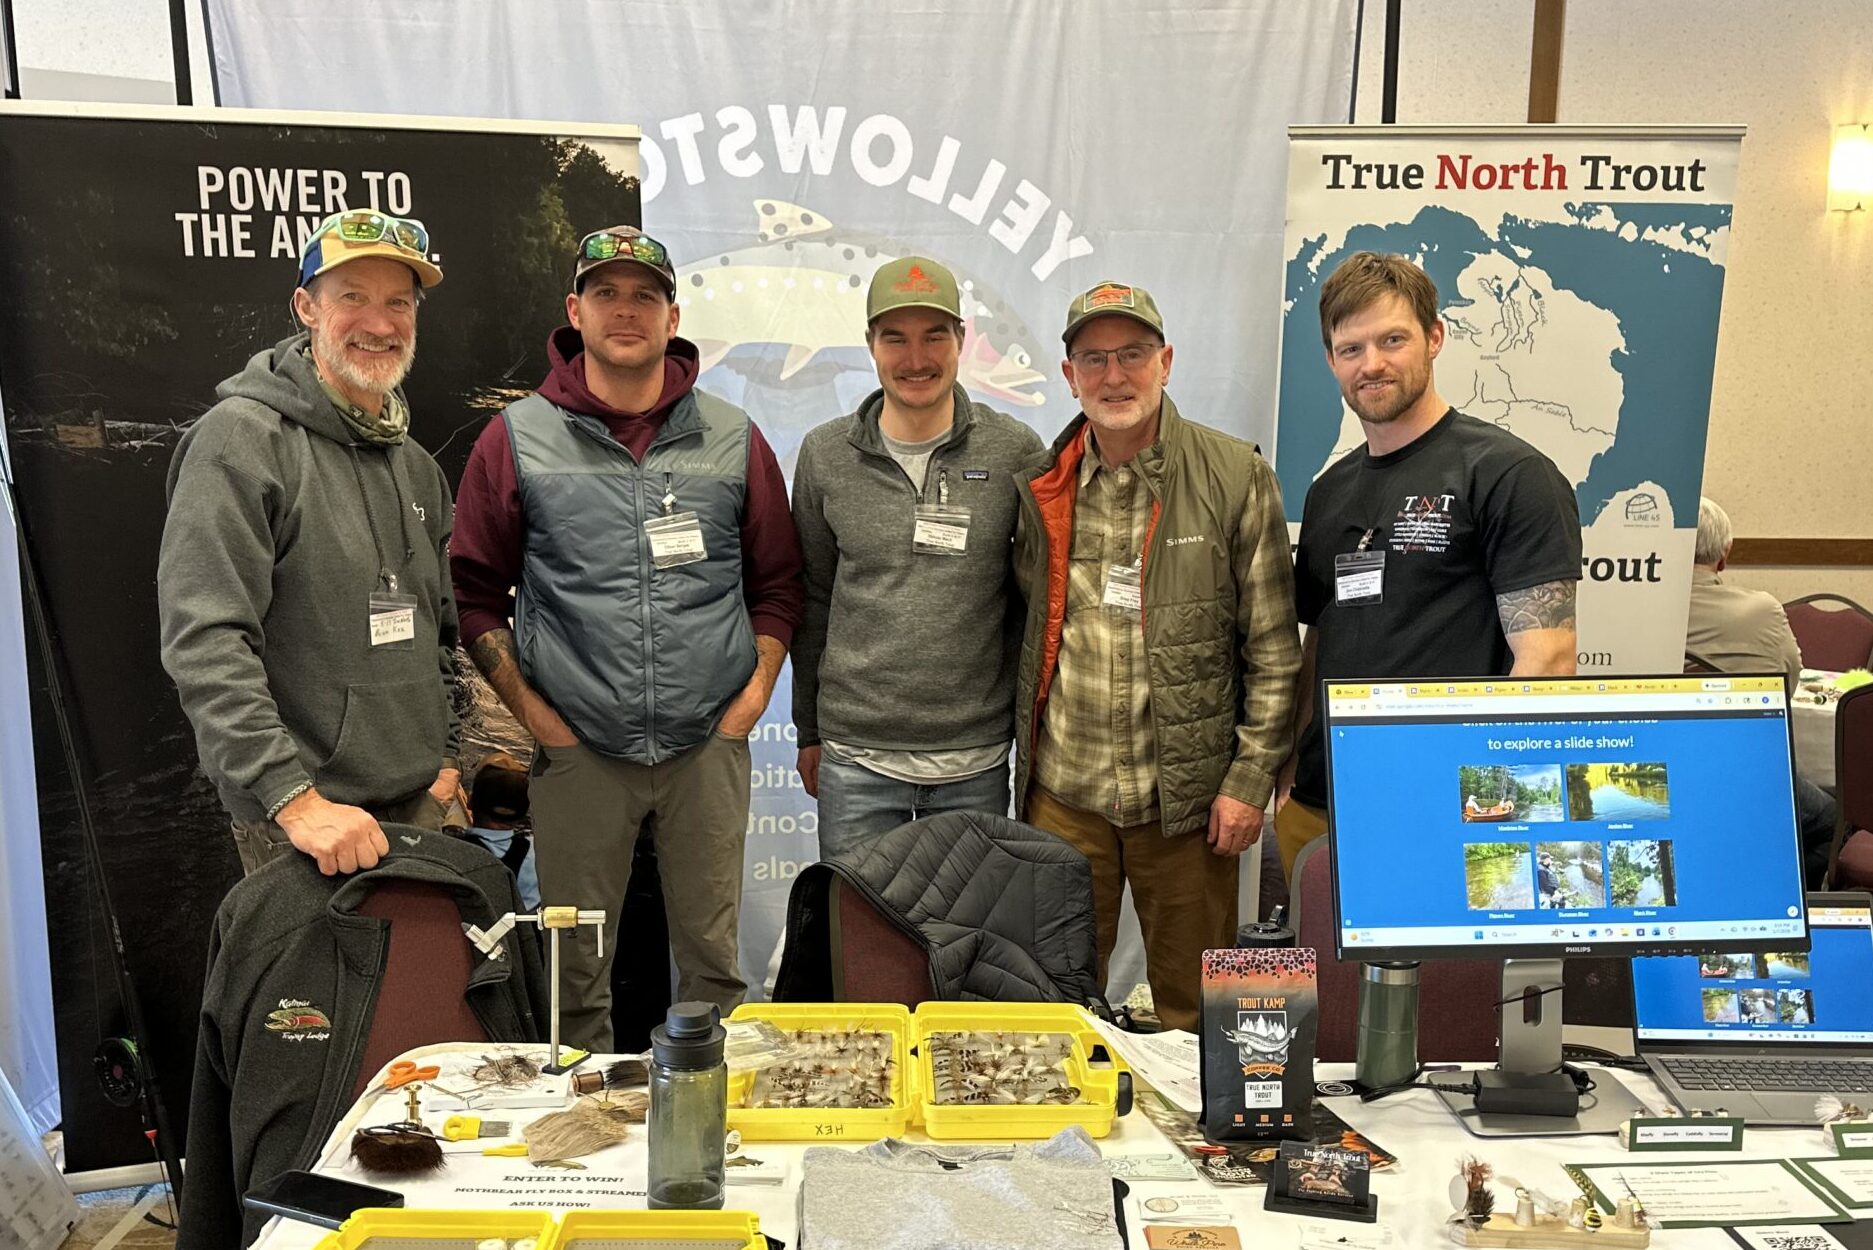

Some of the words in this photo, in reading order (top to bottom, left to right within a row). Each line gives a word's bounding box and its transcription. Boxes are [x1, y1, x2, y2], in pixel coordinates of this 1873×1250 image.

[1321, 154, 1425, 191] True
[1434, 153, 1568, 191] North
[1579, 154, 1706, 191] Trout
[197, 165, 349, 213] POWER
[361, 171, 412, 216] TO
[174, 212, 256, 258] THE
[1166, 535, 1205, 547] SIMMS
[1488, 738, 1502, 750] to
[1504, 737, 1552, 752] explore
[1554, 740, 1562, 749] a
[1564, 736, 1594, 749] slide
[1596, 735, 1634, 748] show!
[1237, 998, 1261, 1009] TROUT
[1264, 998, 1286, 1008] KAMP
[1246, 1083, 1260, 1091] TRUE
[1262, 1083, 1281, 1091] NORTH
[1303, 1148, 1317, 1158] True
[1321, 1150, 1341, 1160] North
[1342, 1152, 1361, 1162] Trout
